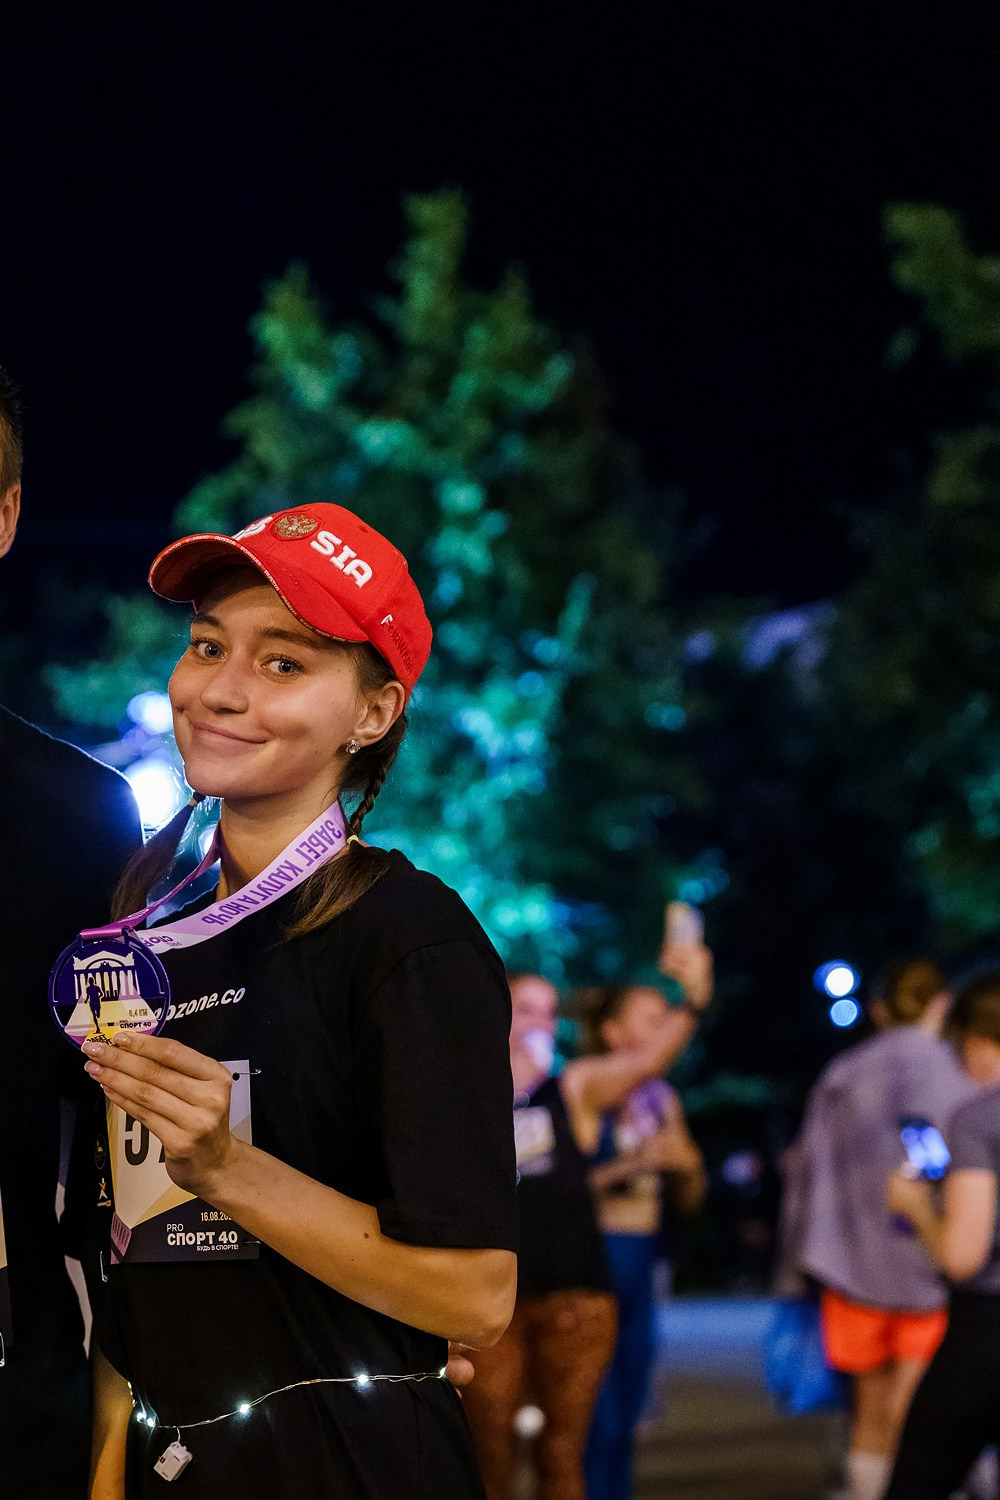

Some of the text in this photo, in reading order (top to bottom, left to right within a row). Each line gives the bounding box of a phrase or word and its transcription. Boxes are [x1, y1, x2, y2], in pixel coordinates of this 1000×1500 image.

[214, 535, 237, 546] RUSSIA
[295, 819, 342, 867] ЗАБЕГ
[201, 902, 250, 925] НОЧЬ
[124, 1111, 166, 1166] 5
[166, 1223, 184, 1232] PRO
[167, 1230, 238, 1246] СПОРТ 40
